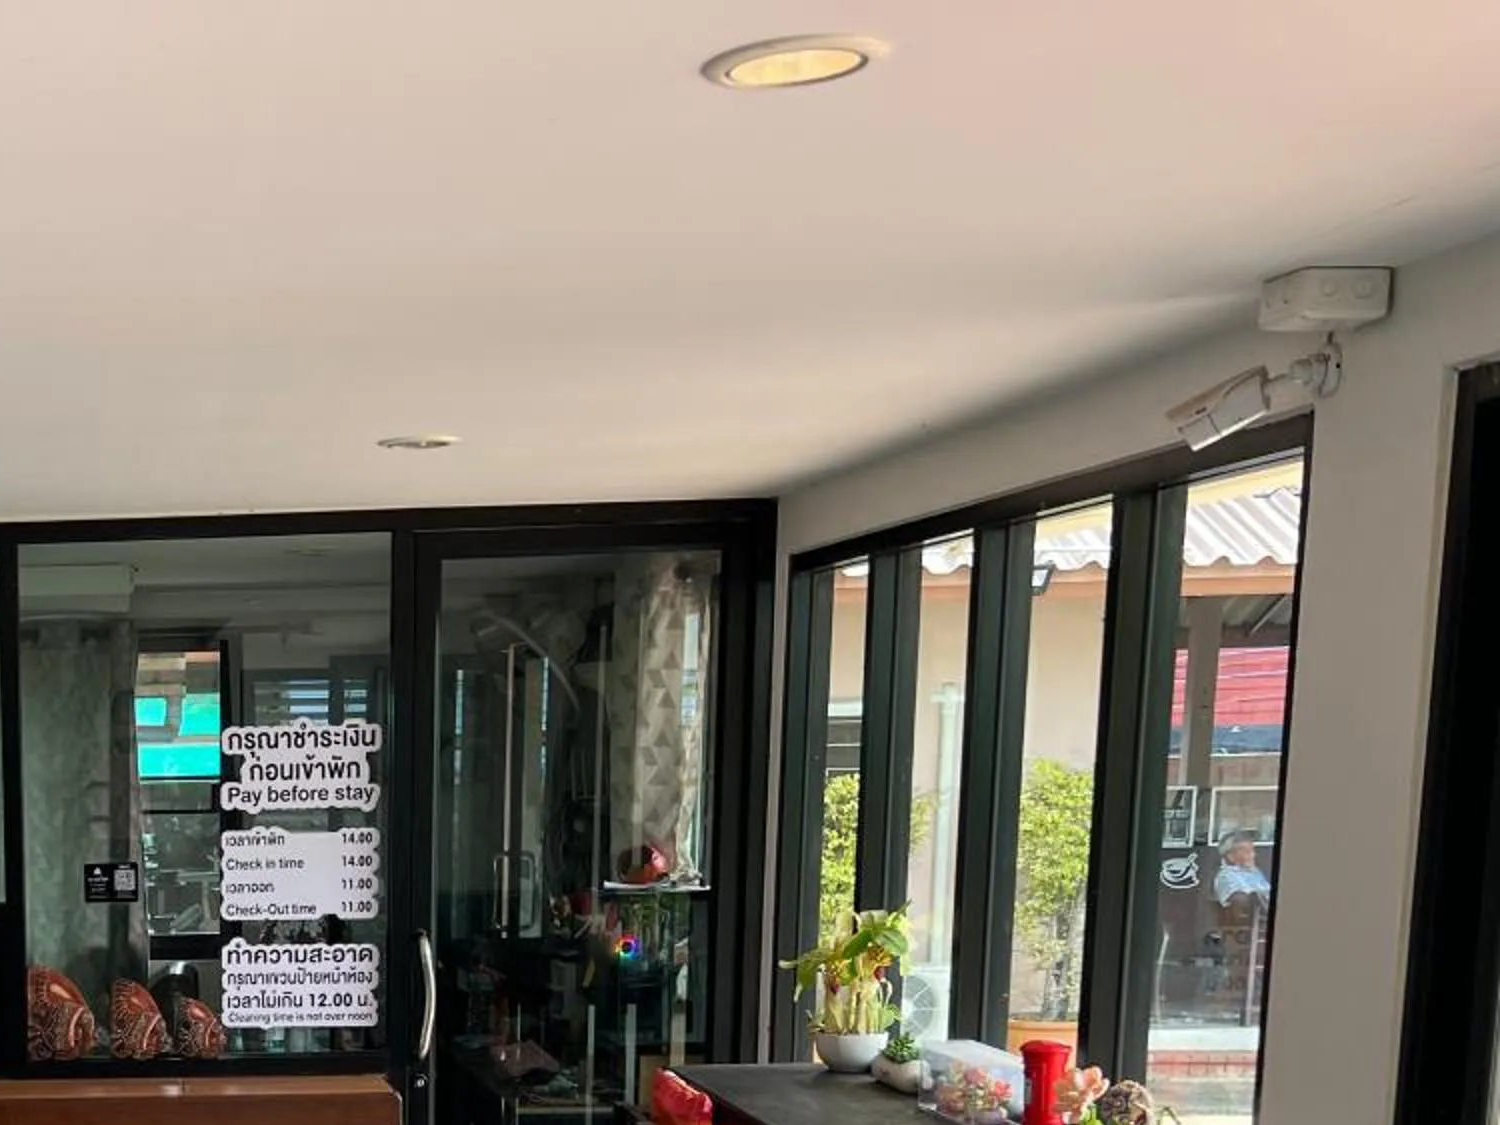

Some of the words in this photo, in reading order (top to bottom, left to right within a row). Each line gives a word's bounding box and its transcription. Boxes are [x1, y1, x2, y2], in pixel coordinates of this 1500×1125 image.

[228, 723, 376, 758] กรุณาชำระเงิน
[250, 754, 361, 781] ก่อนเข้าพัก
[227, 787, 262, 806] Pay
[267, 785, 329, 803] before
[335, 785, 375, 803] stay
[341, 832, 373, 844] 14.00
[225, 858, 262, 871] Check
[266, 857, 276, 869] in
[278, 857, 305, 869] time
[341, 855, 373, 867] 14.00
[341, 878, 373, 890] 11.00
[226, 903, 289, 916] Check-Out
[291, 903, 317, 915] time
[341, 901, 372, 913] 11.00
[227, 942, 373, 964] ทำความสะอาด
[309, 993, 353, 1007] 12.00
[228, 1012, 270, 1024] Cleaning
[325, 1013, 345, 1021] over
